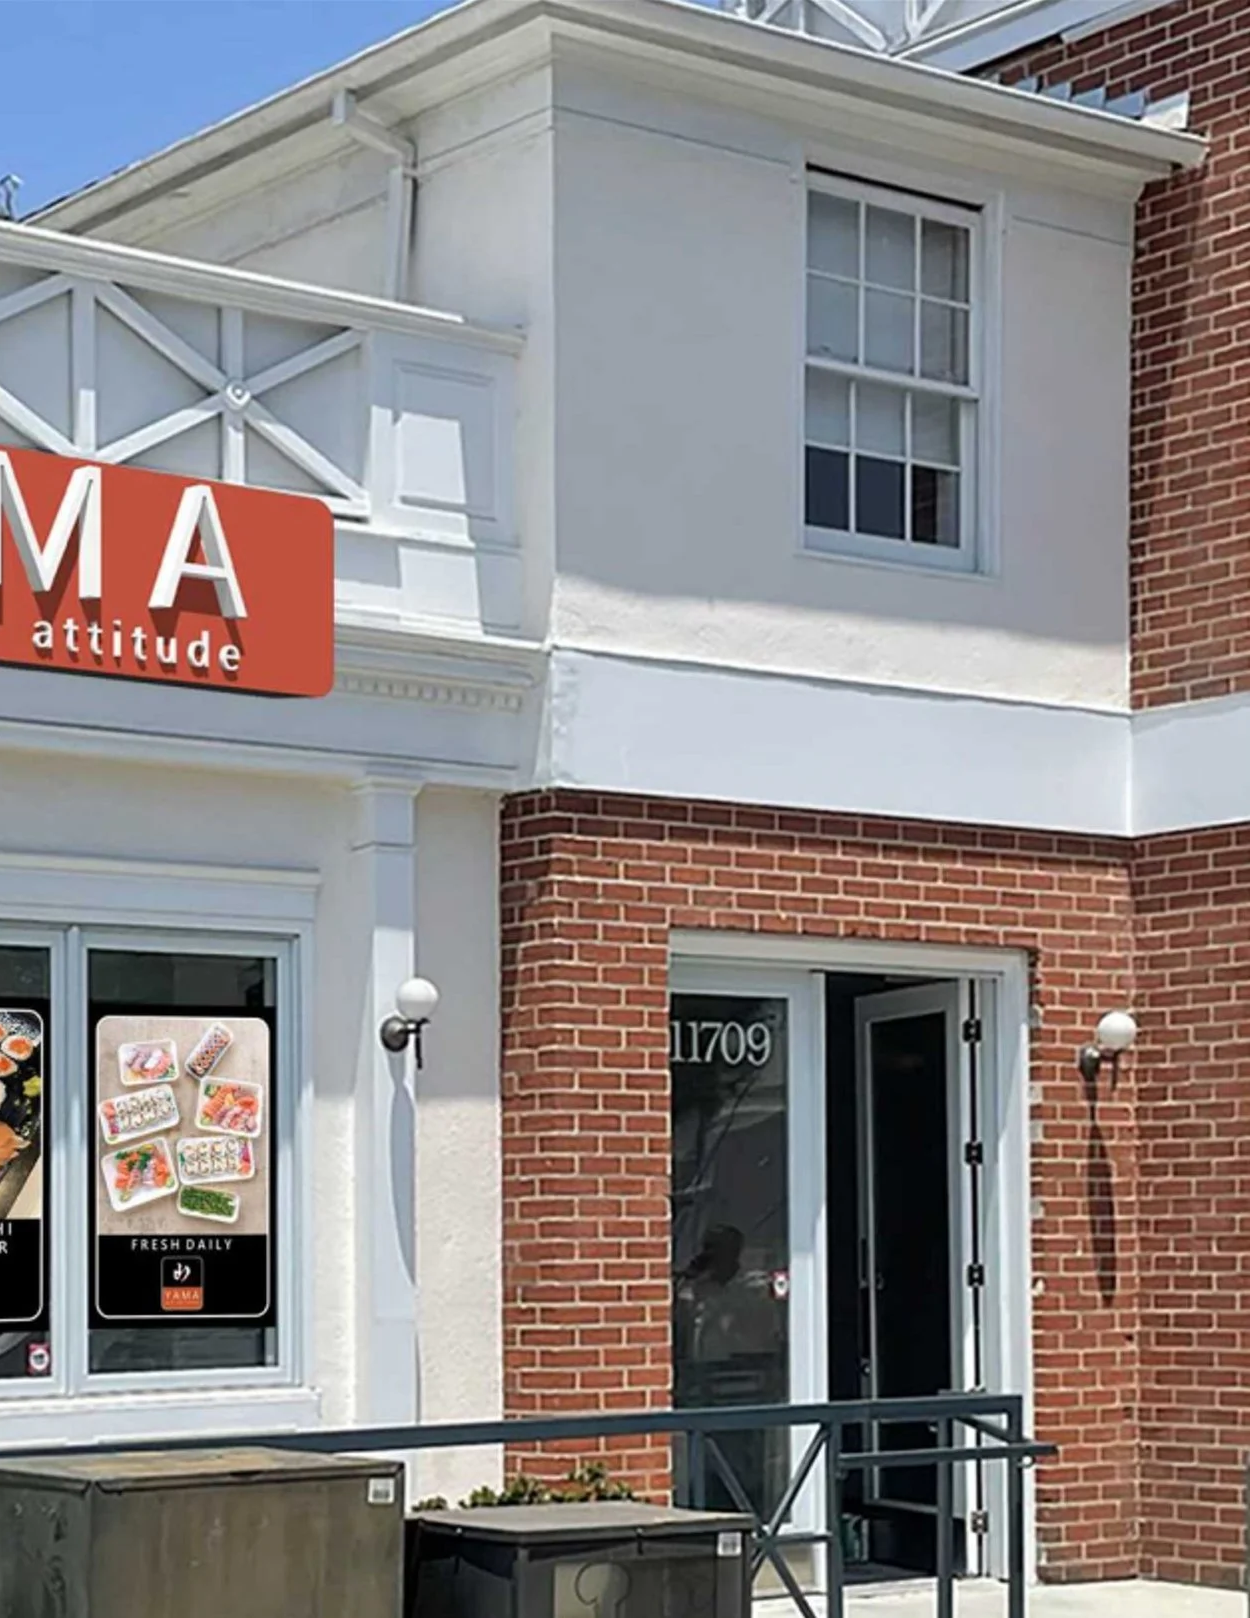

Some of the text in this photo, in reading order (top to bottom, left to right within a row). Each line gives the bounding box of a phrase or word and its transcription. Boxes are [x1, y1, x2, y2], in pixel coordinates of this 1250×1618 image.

[32, 617, 241, 671] attitude
[669, 1021, 771, 1066] 11709
[131, 1238, 233, 1250] FRESH DAILY
[165, 1290, 199, 1300] YAMA
